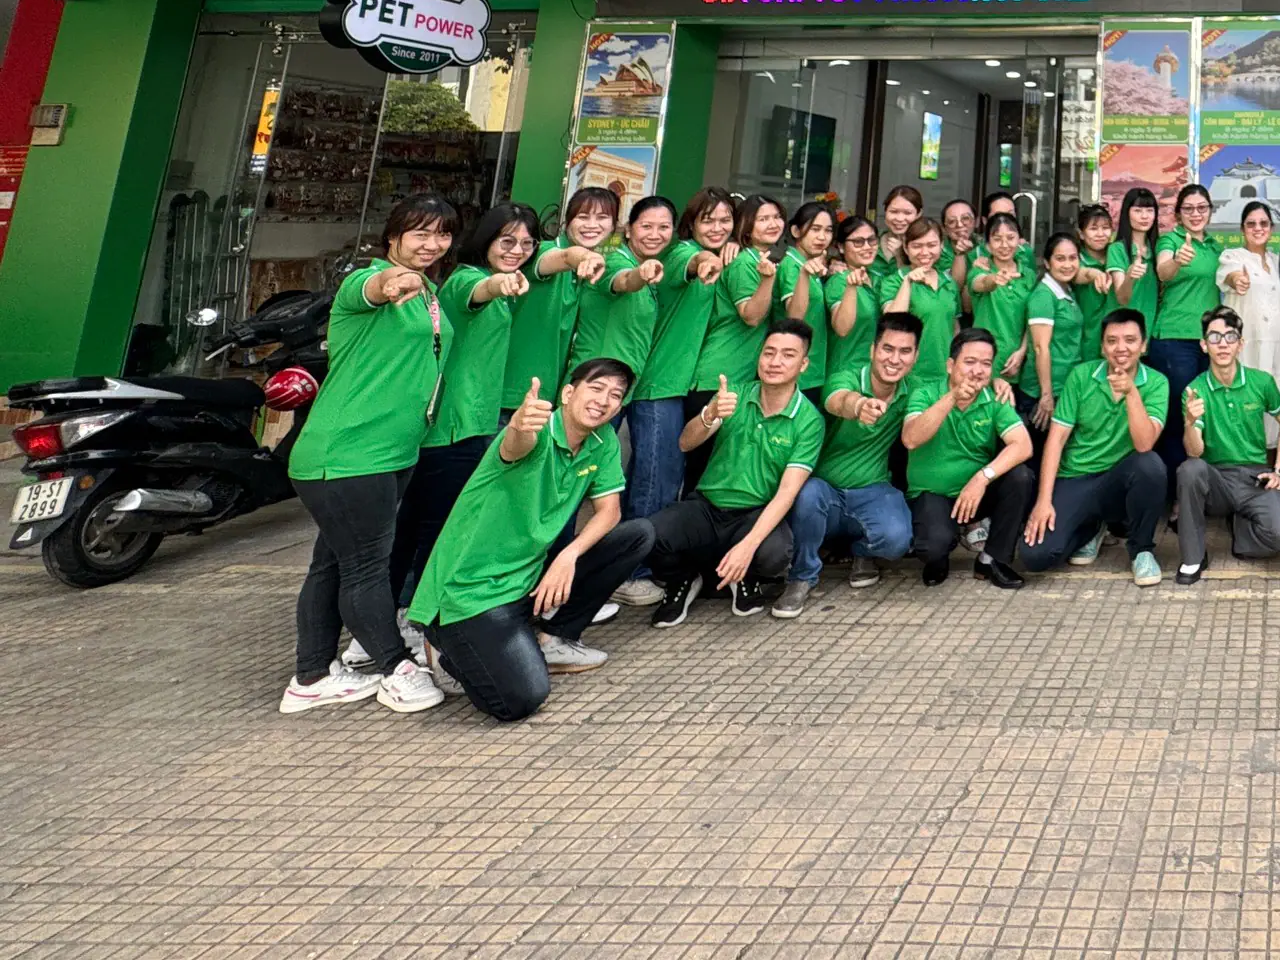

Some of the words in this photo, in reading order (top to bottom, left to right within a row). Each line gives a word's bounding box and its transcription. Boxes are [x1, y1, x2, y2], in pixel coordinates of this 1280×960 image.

[414, 13, 475, 40] POWER
[391, 46, 417, 60] Since
[419, 51, 441, 63] 2011
[19, 499, 58, 520] 2899
